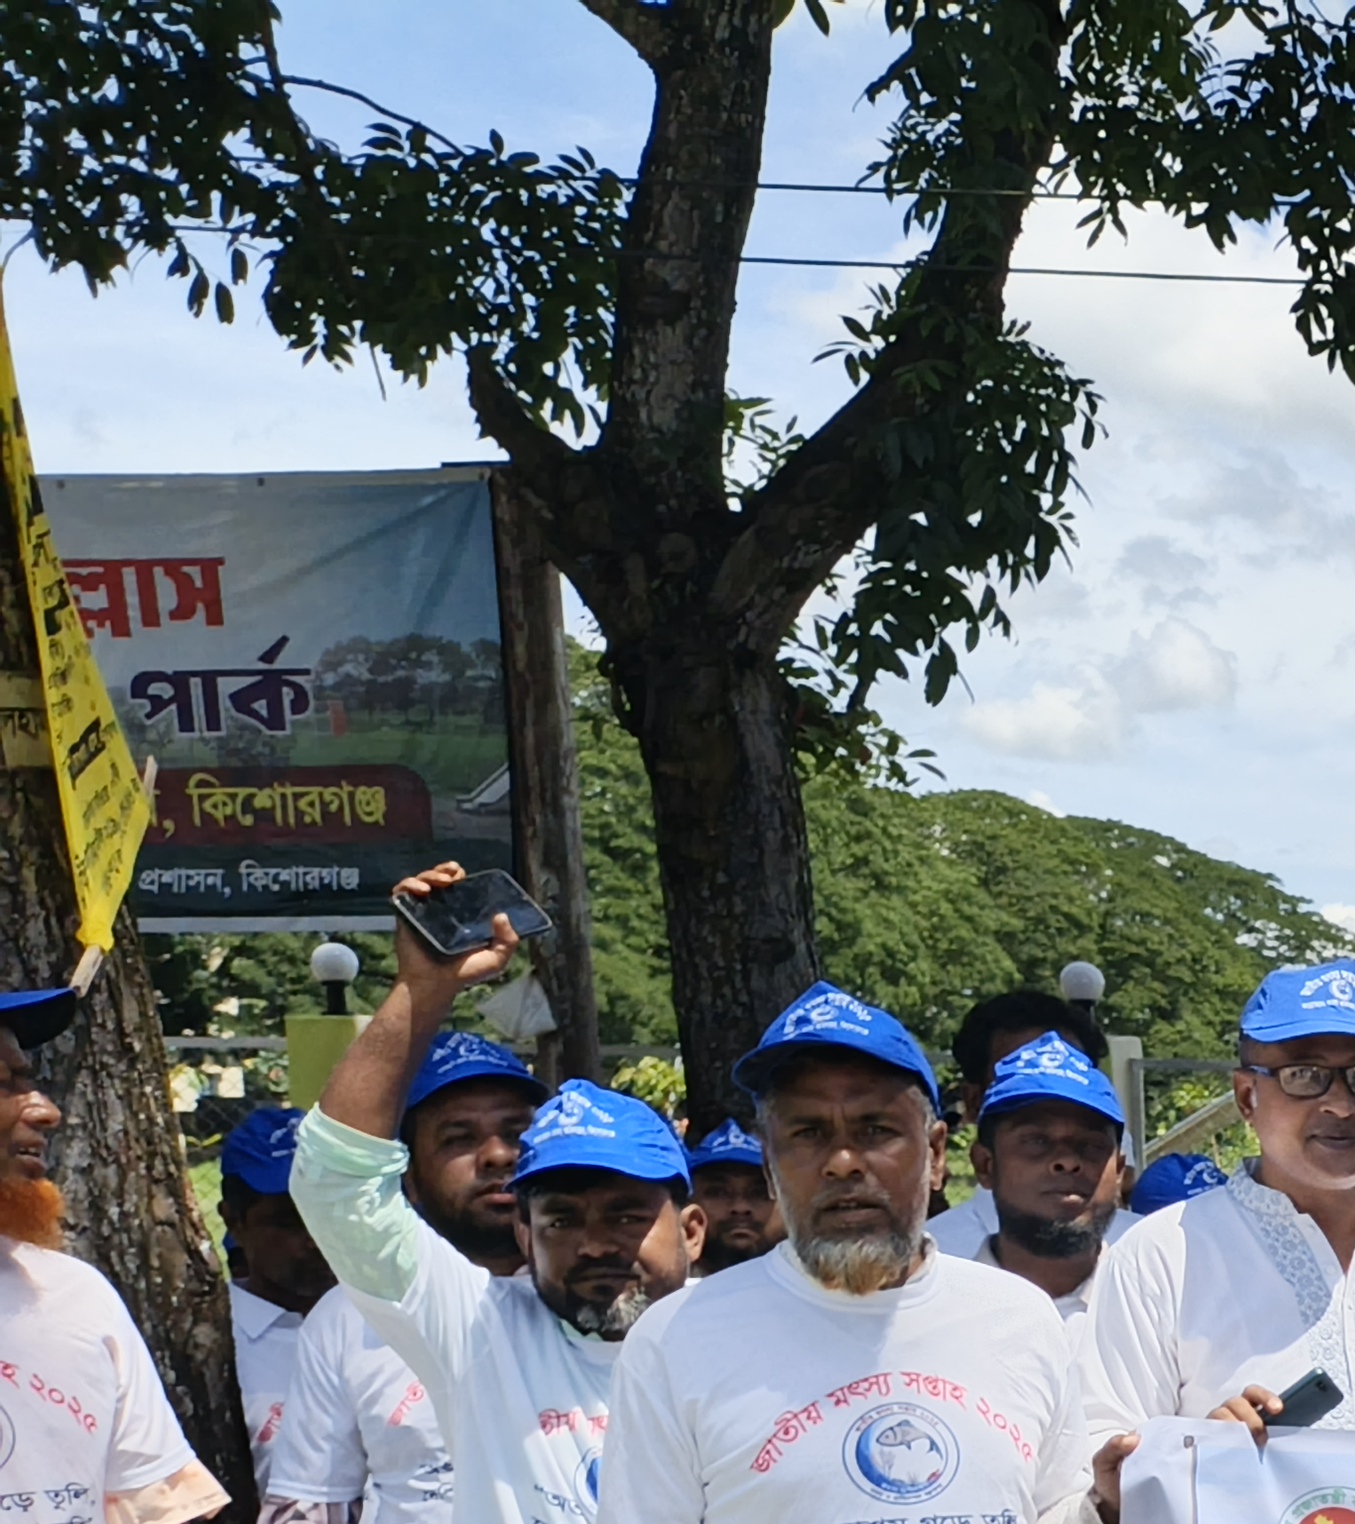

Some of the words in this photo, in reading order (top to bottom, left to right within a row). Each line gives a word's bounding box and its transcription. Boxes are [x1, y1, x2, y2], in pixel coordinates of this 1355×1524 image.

[130, 635, 312, 733] পার্ক
[186, 772, 388, 828] কিশোরগঞ্জ
[239, 859, 360, 893] কিশোরগঞ্জ
[30, 1373, 98, 1435] ২০২৫
[750, 1400, 825, 1475] জাতীয়
[826, 1372, 893, 1409] মৎস্য
[900, 1371, 969, 1411] সপ্তাহ
[976, 1396, 1035, 1464] ২০২৫
[0, 1490, 37, 1512] ড়ে
